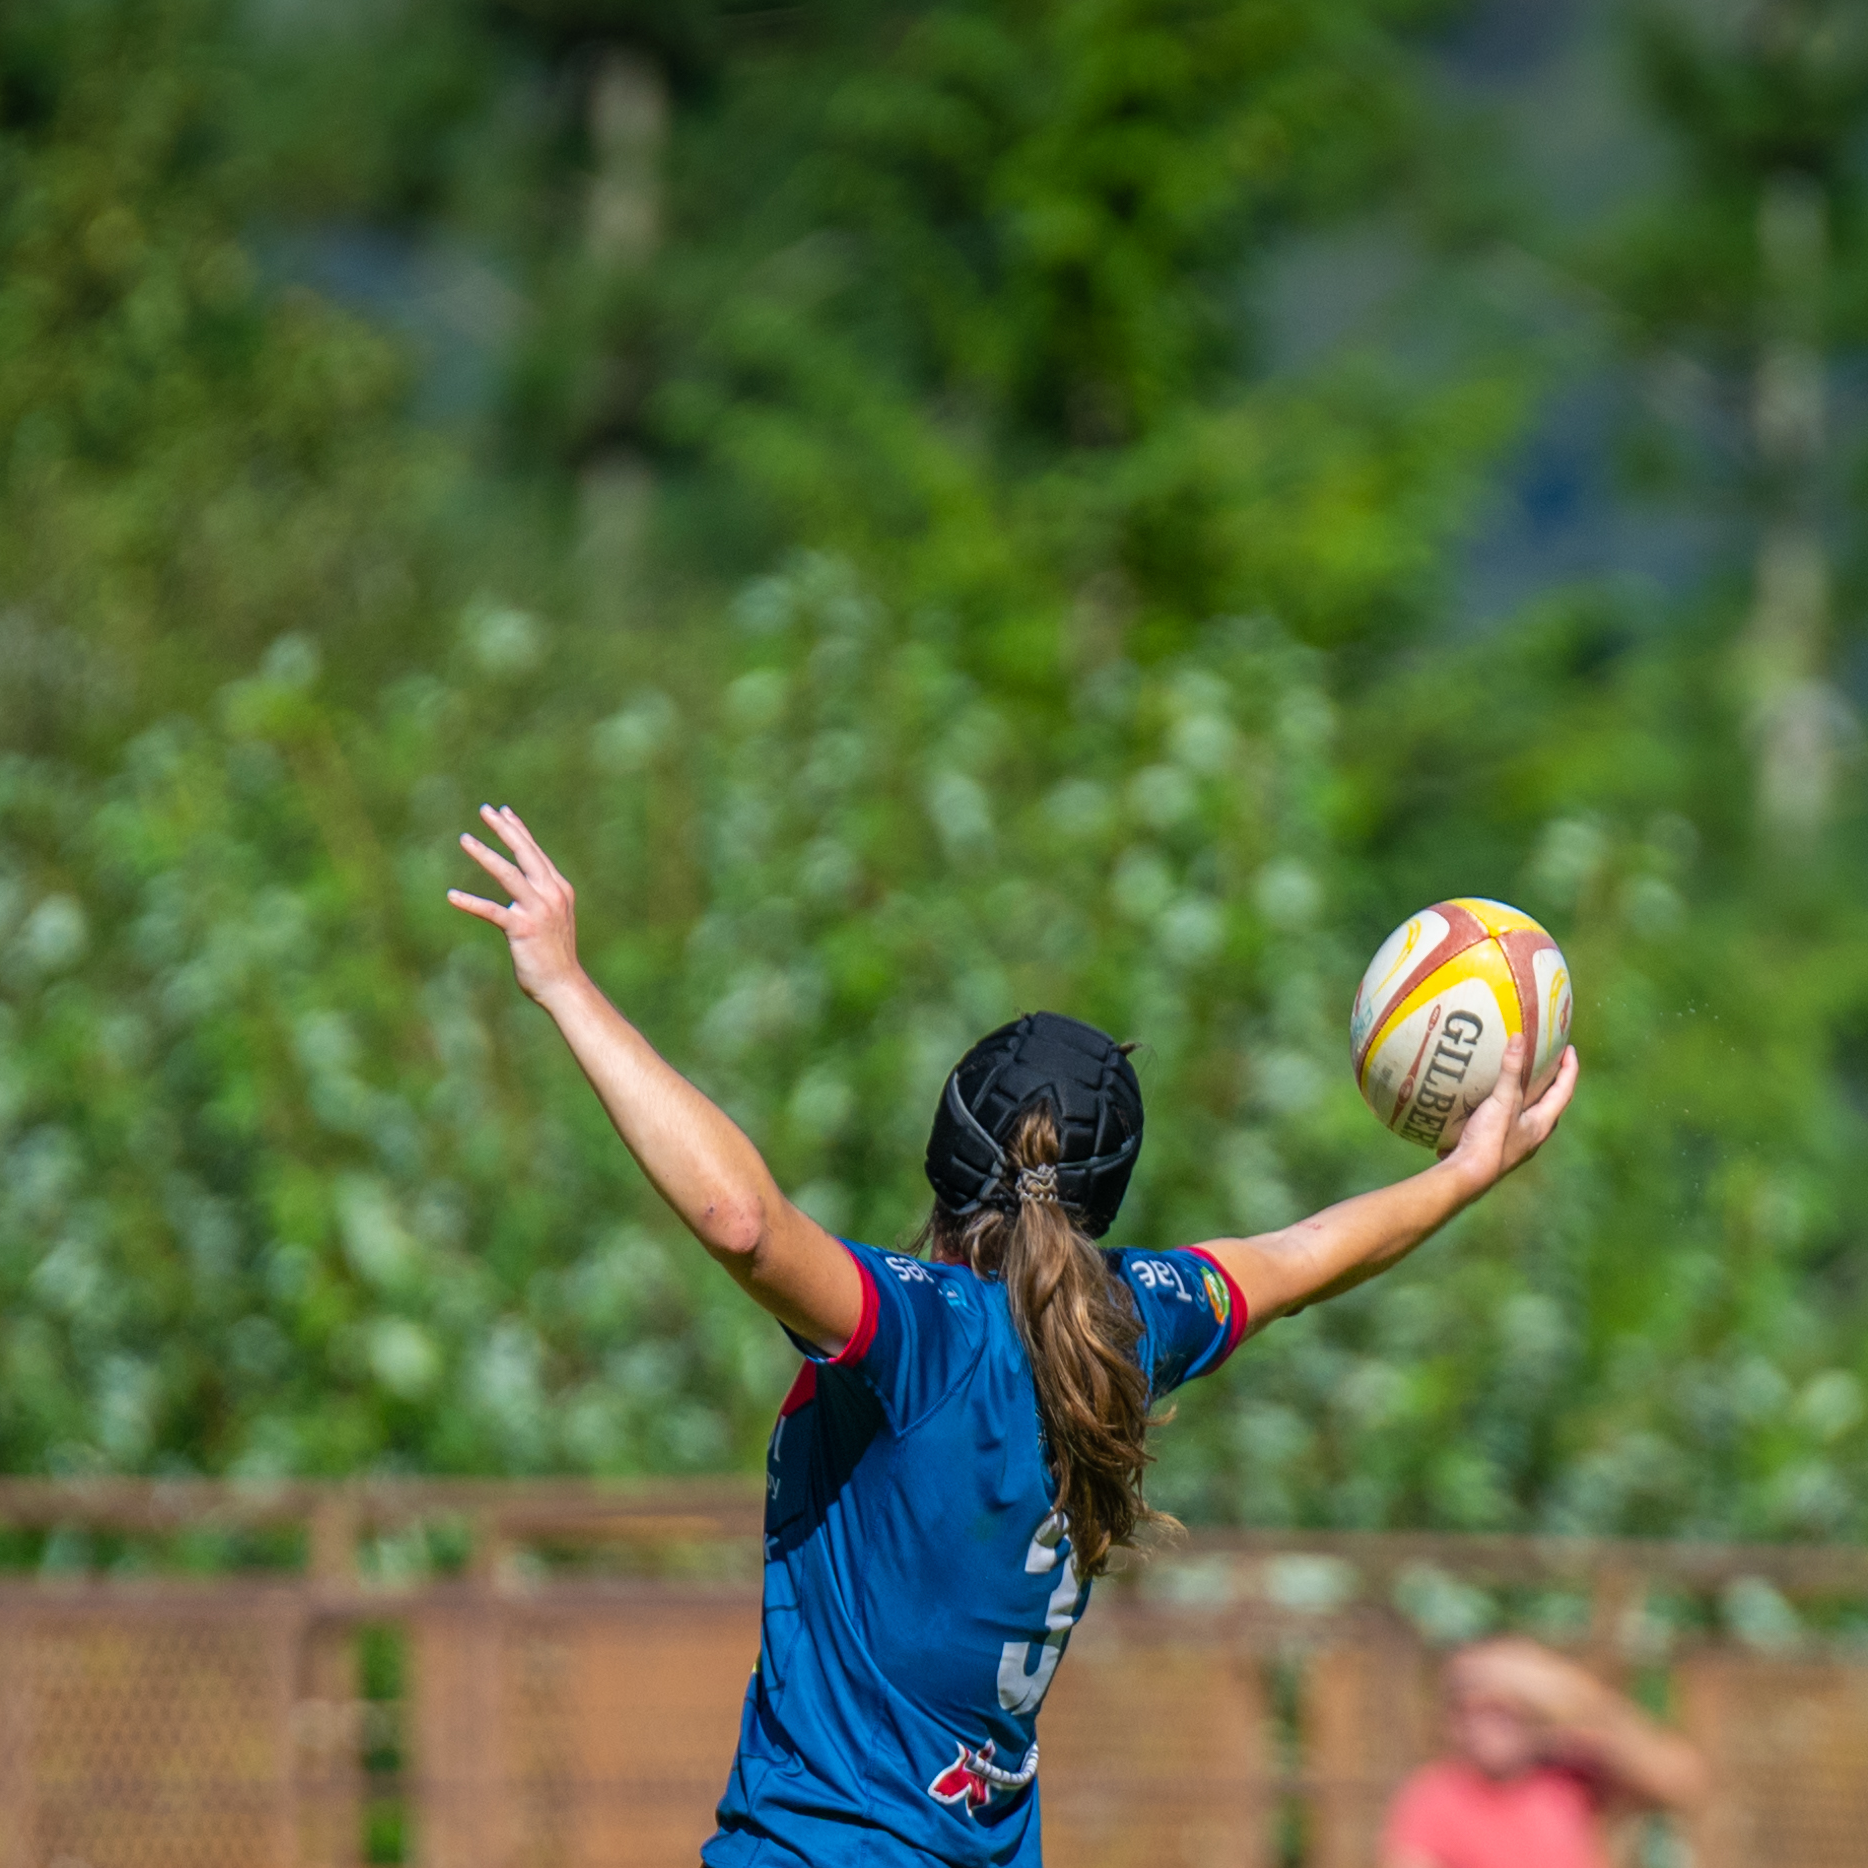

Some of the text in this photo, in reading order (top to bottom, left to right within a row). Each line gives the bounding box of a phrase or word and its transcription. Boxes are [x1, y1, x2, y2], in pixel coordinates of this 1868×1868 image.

[1399, 1009, 1484, 1150] GILBER
[1131, 1259, 1192, 1301] Tae
[997, 1510, 1073, 1715] 3
